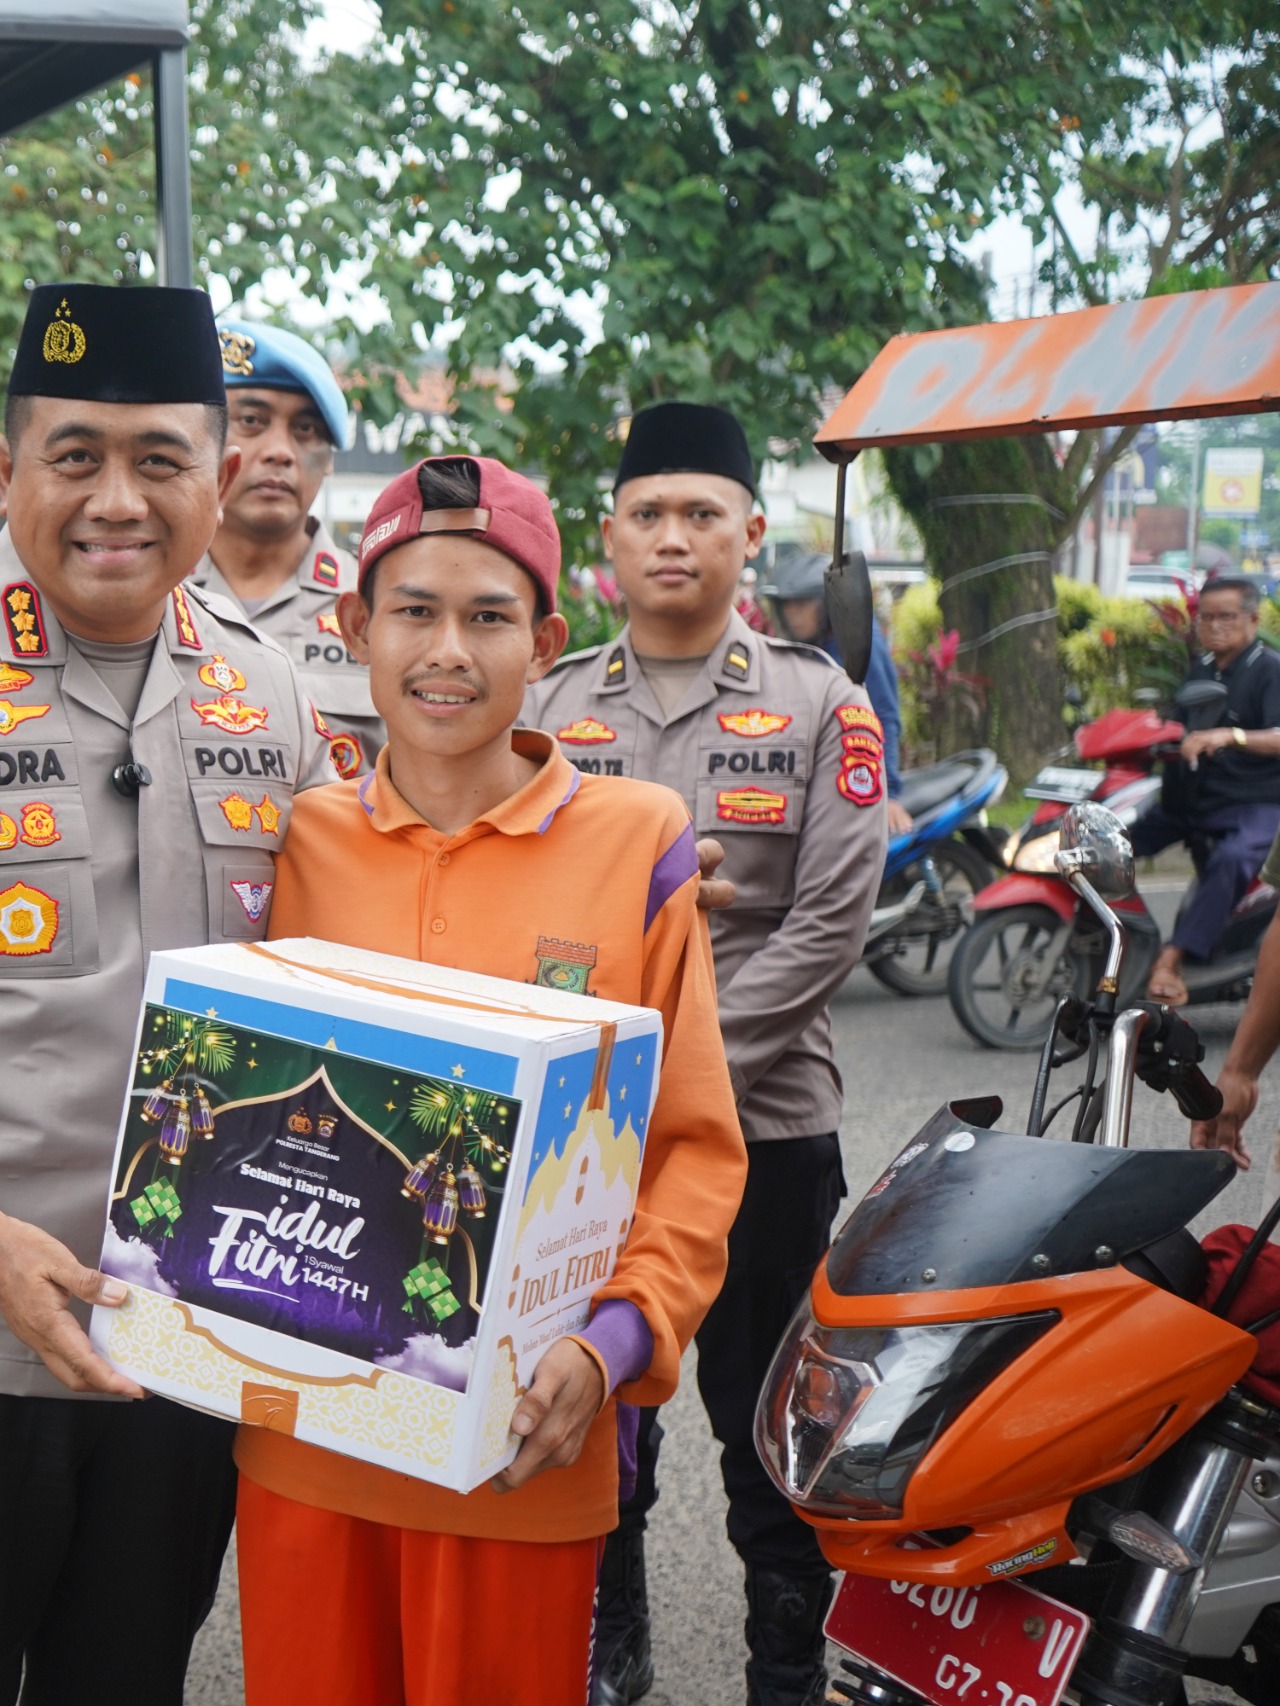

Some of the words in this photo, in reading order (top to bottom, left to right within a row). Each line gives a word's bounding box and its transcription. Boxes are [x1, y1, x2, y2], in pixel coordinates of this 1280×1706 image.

[305, 644, 358, 663] POL
[195, 746, 287, 779] POLRI
[708, 751, 796, 775] POLRI
[275, 1139, 304, 1152] POLRESTA
[304, 1145, 340, 1161] TANGERANG
[287, 1135, 313, 1148] Keluarga
[314, 1141, 330, 1153] Besar
[240, 1163, 292, 1189] Selamat
[294, 1178, 324, 1198] Hari
[327, 1188, 361, 1209] Raya
[278, 1161, 329, 1181] Mengucapkan
[265, 1194, 365, 1260] idul
[536, 1233, 568, 1261] Selamat
[569, 1223, 587, 1247] Hari
[588, 1220, 608, 1240] Raya
[208, 1205, 301, 1286] Fitri
[518, 1268, 561, 1318] IDUL
[563, 1246, 612, 1295] FITRI
